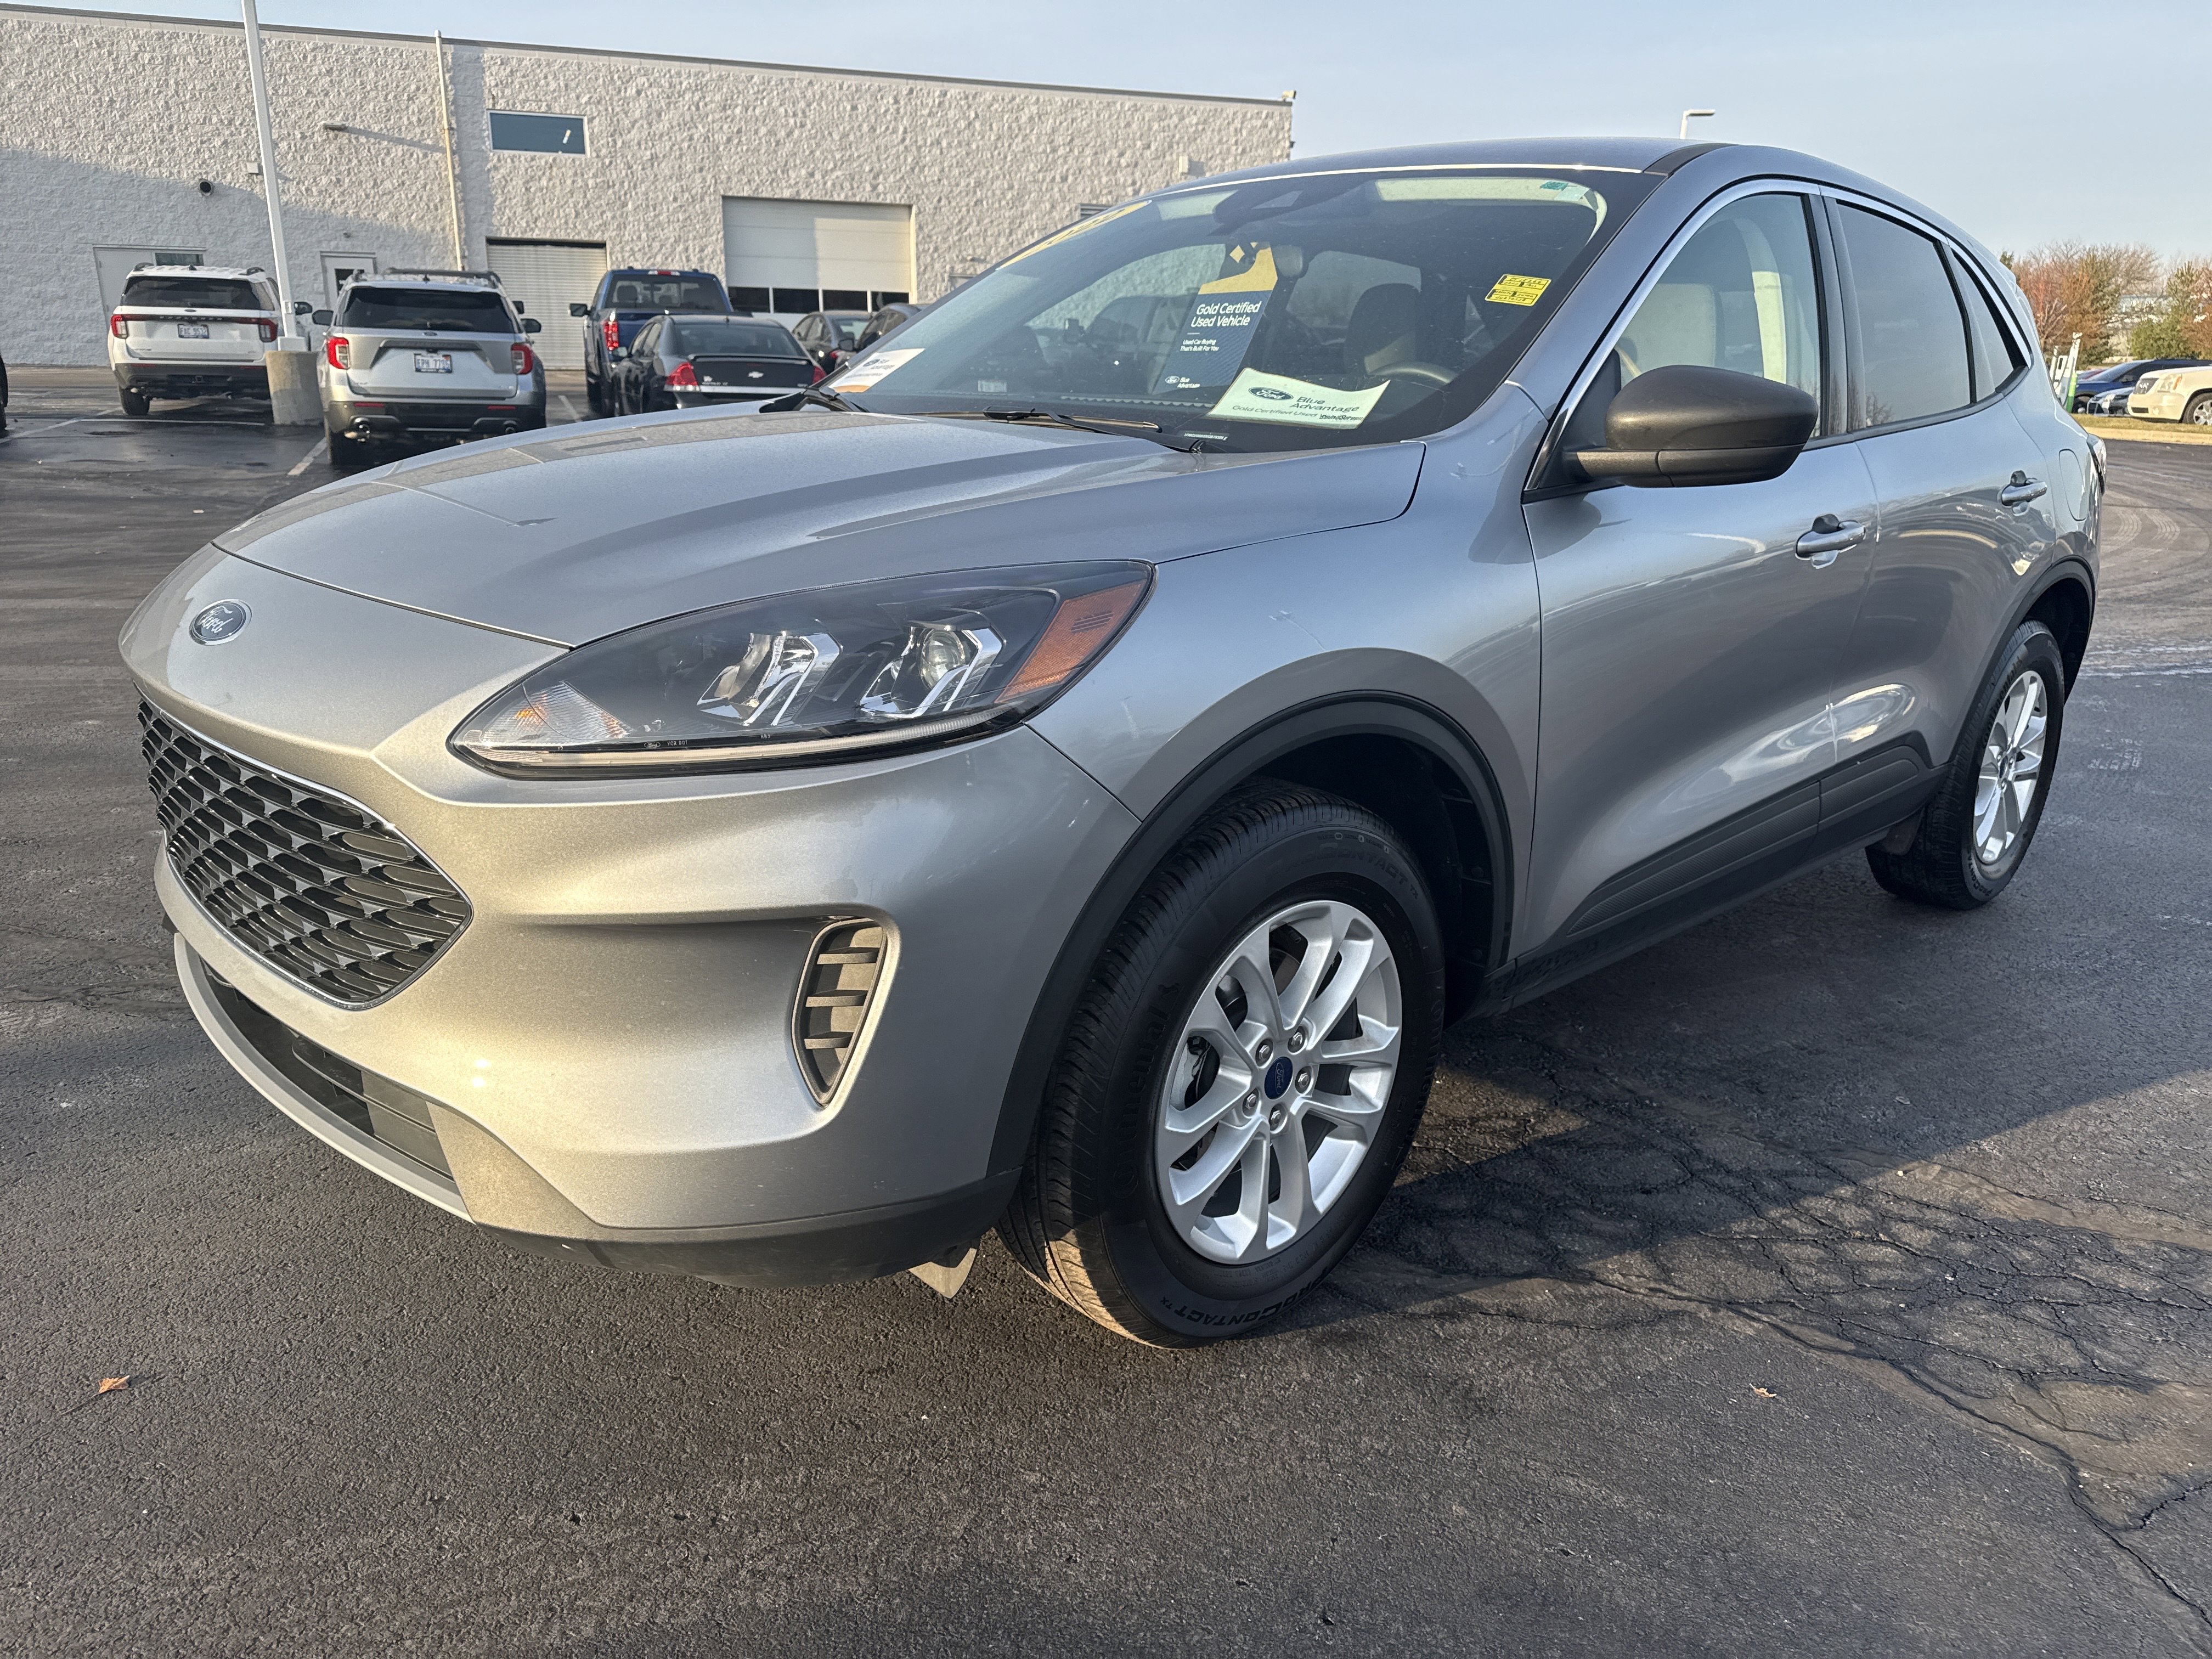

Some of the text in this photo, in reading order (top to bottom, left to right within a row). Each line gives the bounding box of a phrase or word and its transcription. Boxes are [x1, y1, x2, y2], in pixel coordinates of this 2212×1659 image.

[1196, 301, 1262, 315] Gold Certified
[1190, 314, 1251, 327] Used Vehicle
[1256, 389, 1325, 404] Ford Blue
[1289, 403, 1360, 413] Advantage
[1113, 1003, 1172, 1199] Continental
[1159, 1296, 1172, 1310] TX
